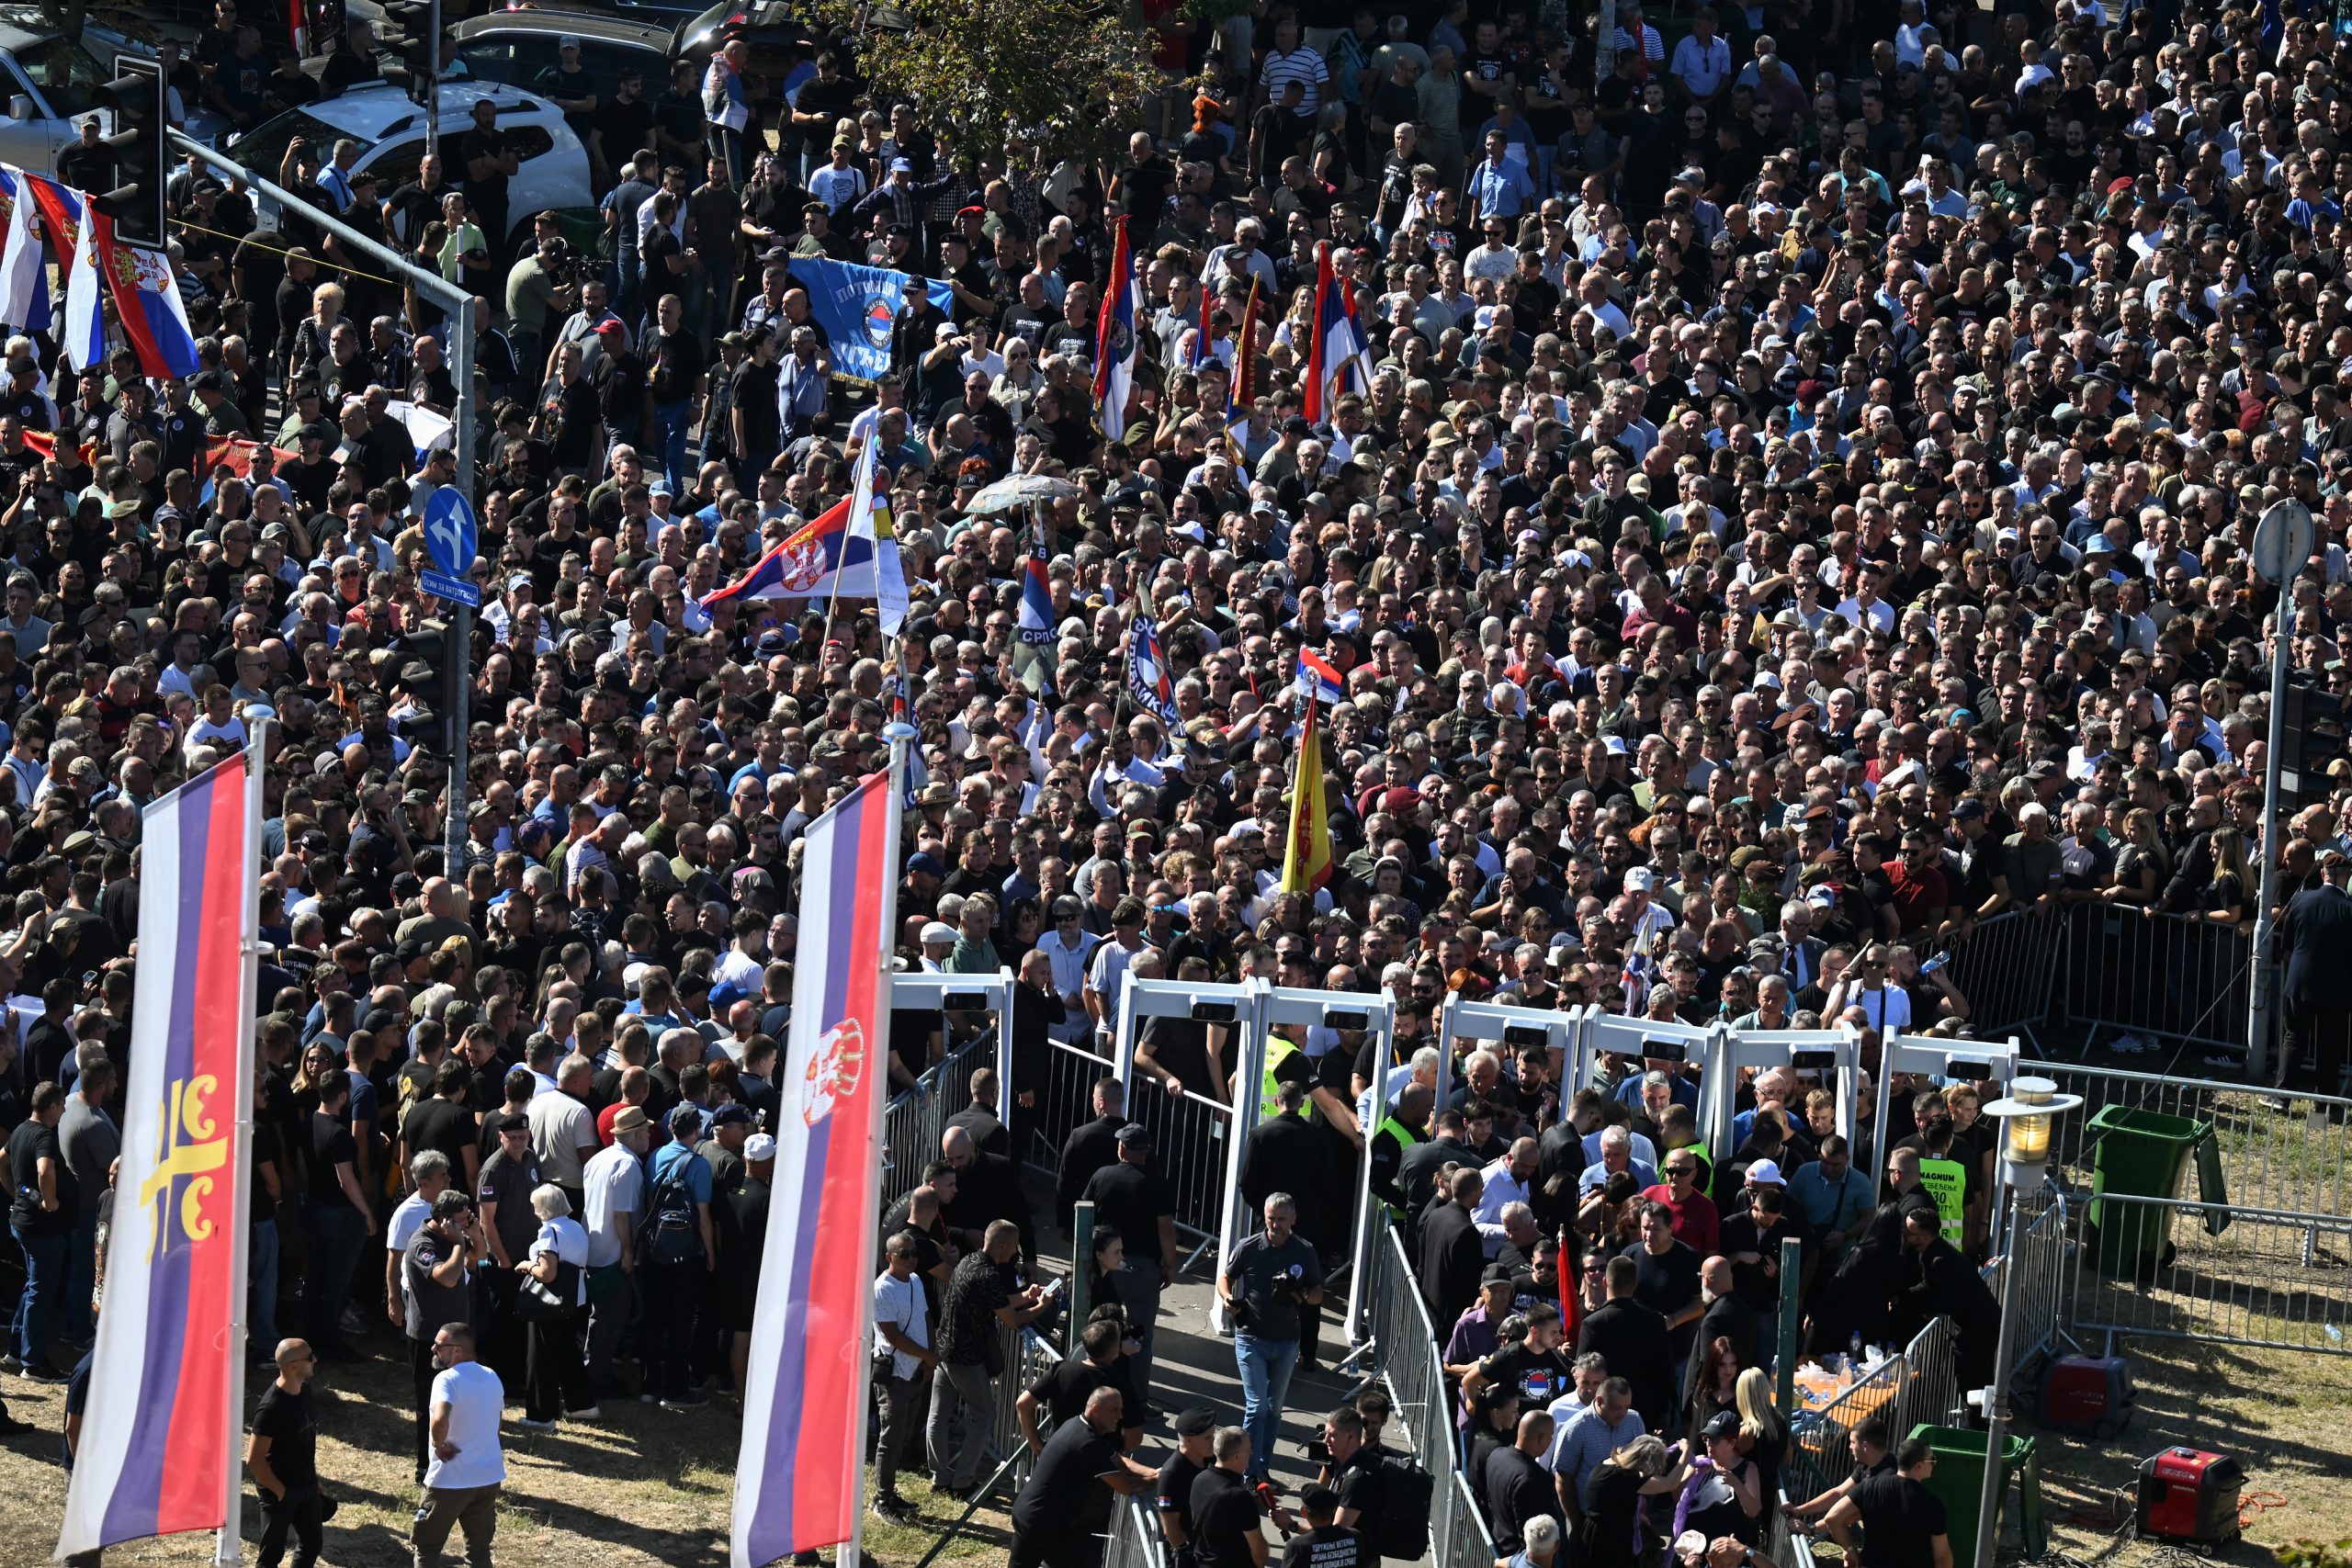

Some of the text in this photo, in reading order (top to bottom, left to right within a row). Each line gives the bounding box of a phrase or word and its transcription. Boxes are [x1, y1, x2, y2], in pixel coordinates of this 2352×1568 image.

[423, 575, 477, 603] Осим за ватрогасце
[1919, 1172, 1955, 1182] MAGNUM
[1921, 1181, 1958, 1191] ЕЗБЕЂЕЊЕ
[2172, 1484, 2196, 1493] HONDA
